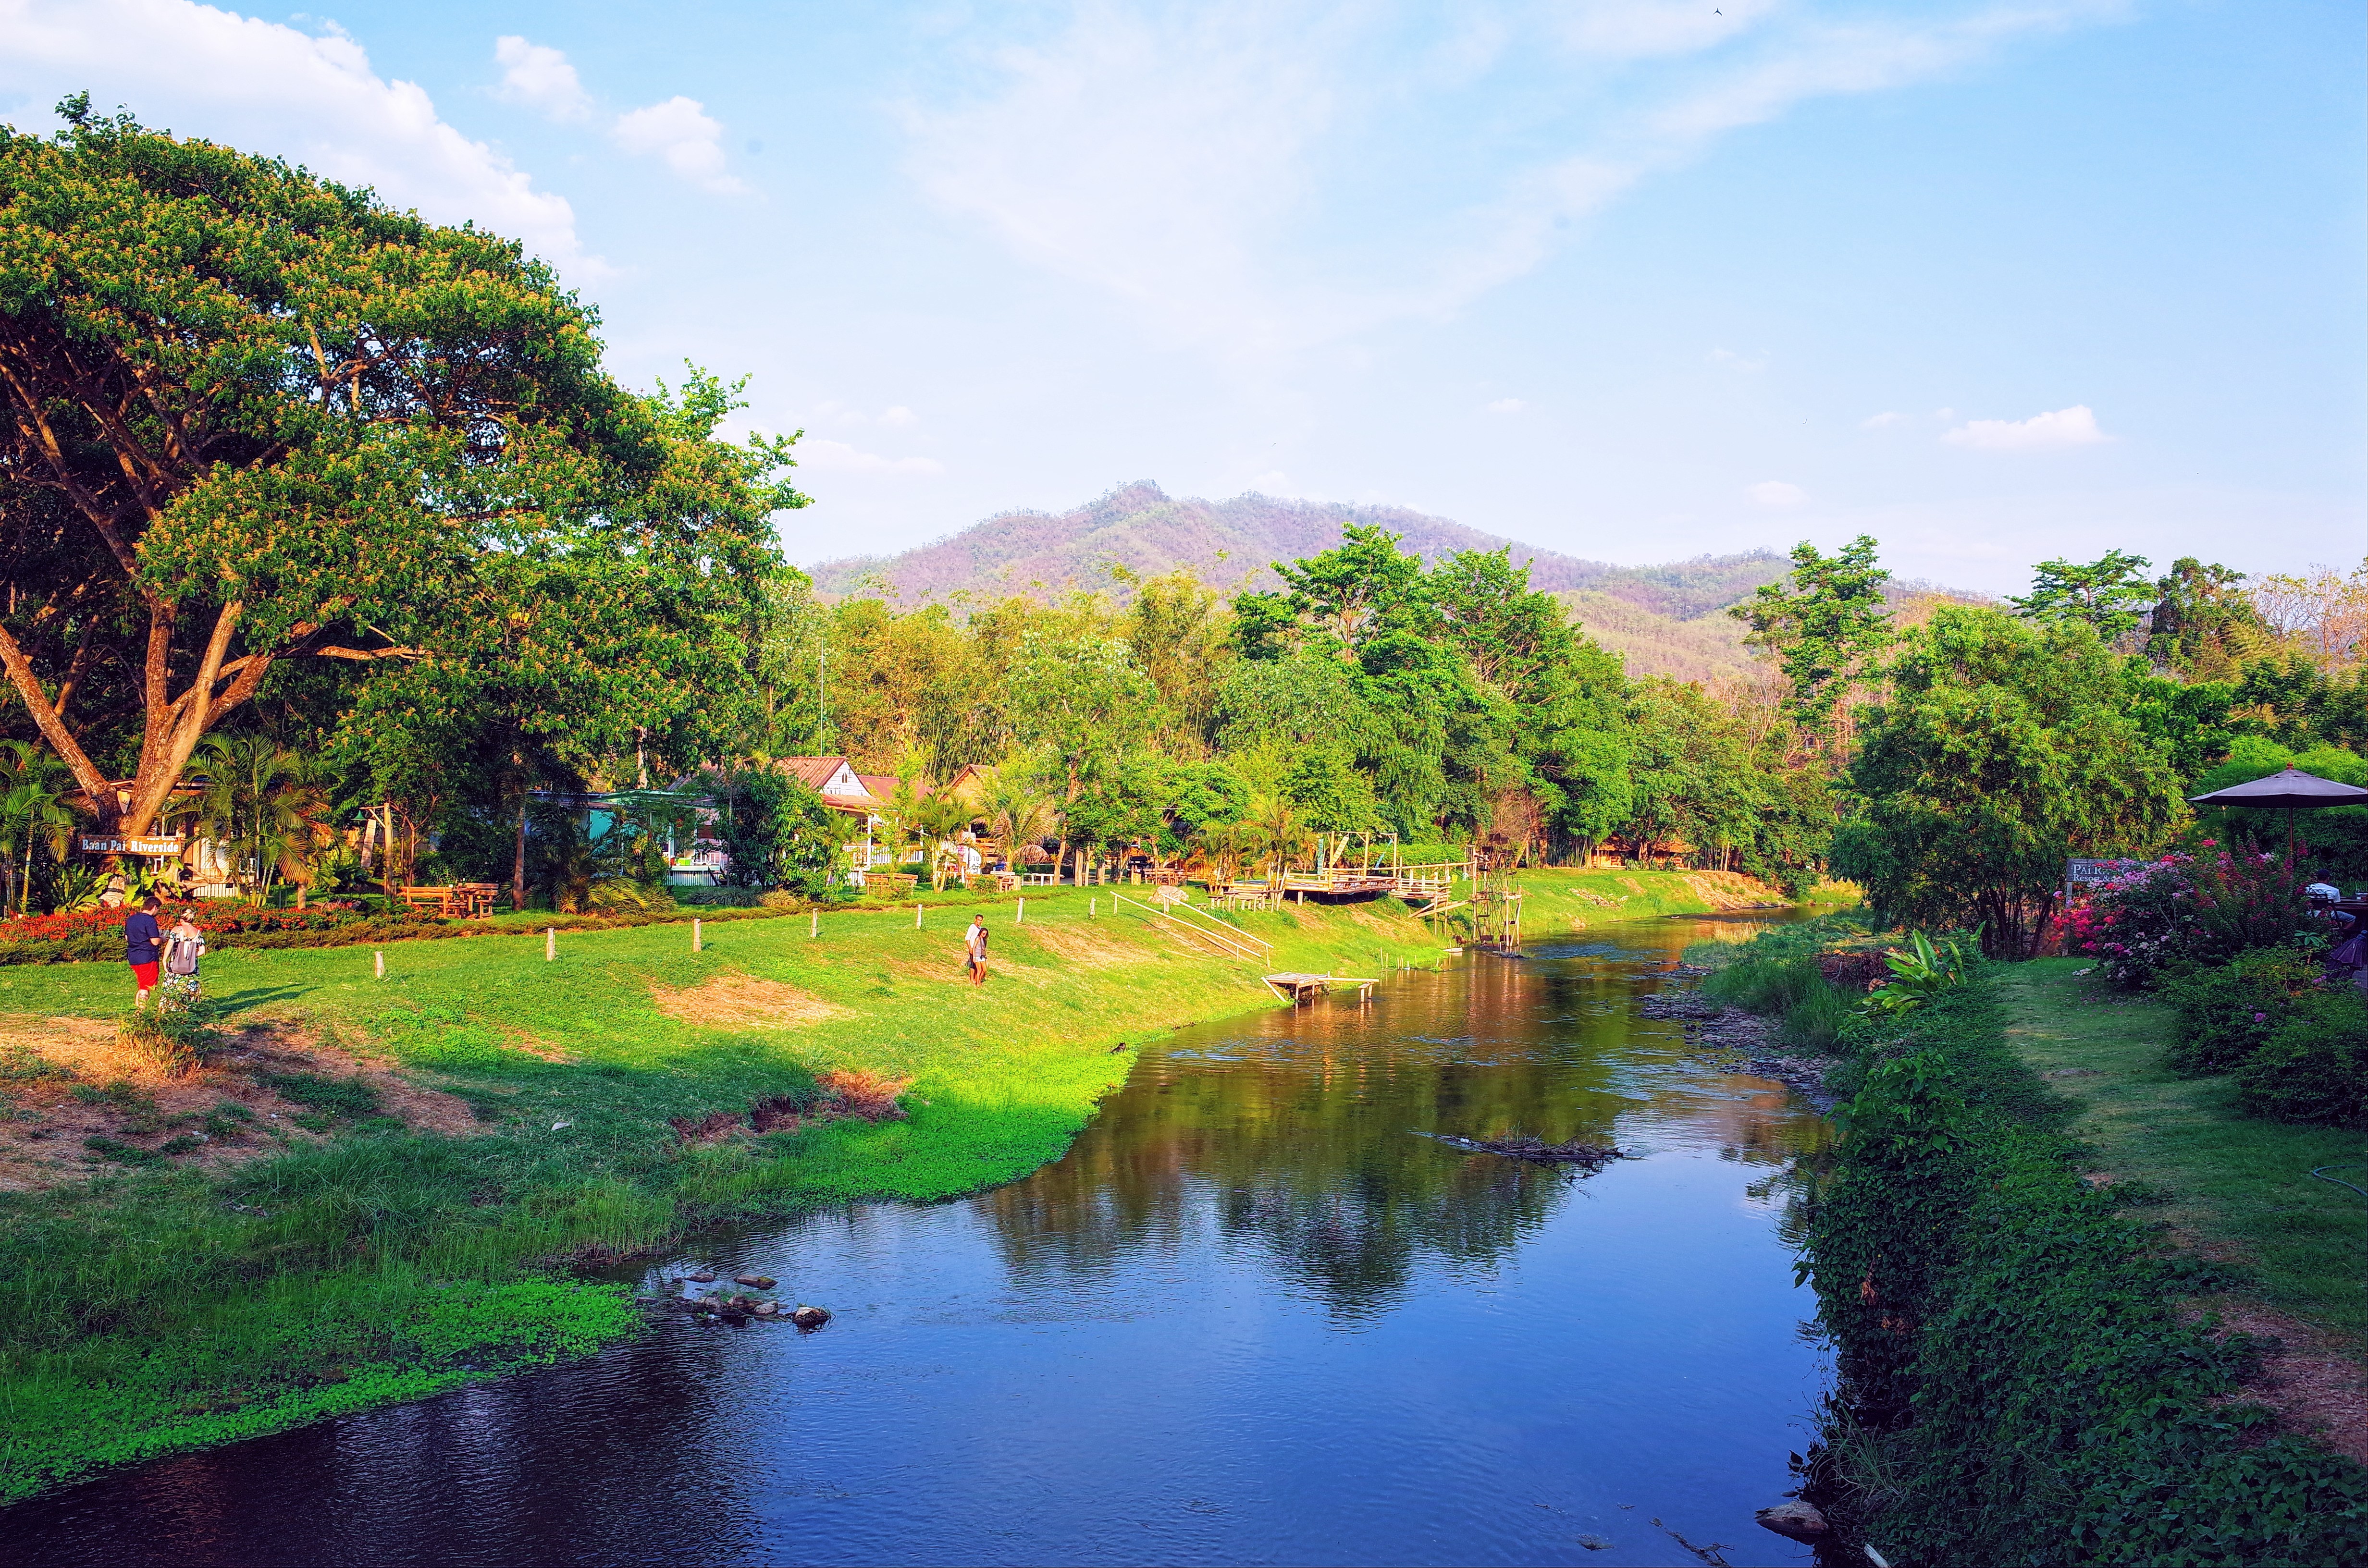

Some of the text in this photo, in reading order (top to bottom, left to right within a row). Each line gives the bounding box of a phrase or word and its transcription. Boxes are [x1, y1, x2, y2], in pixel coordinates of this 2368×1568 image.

[82, 839, 179, 853] Baan Pai Riverside
